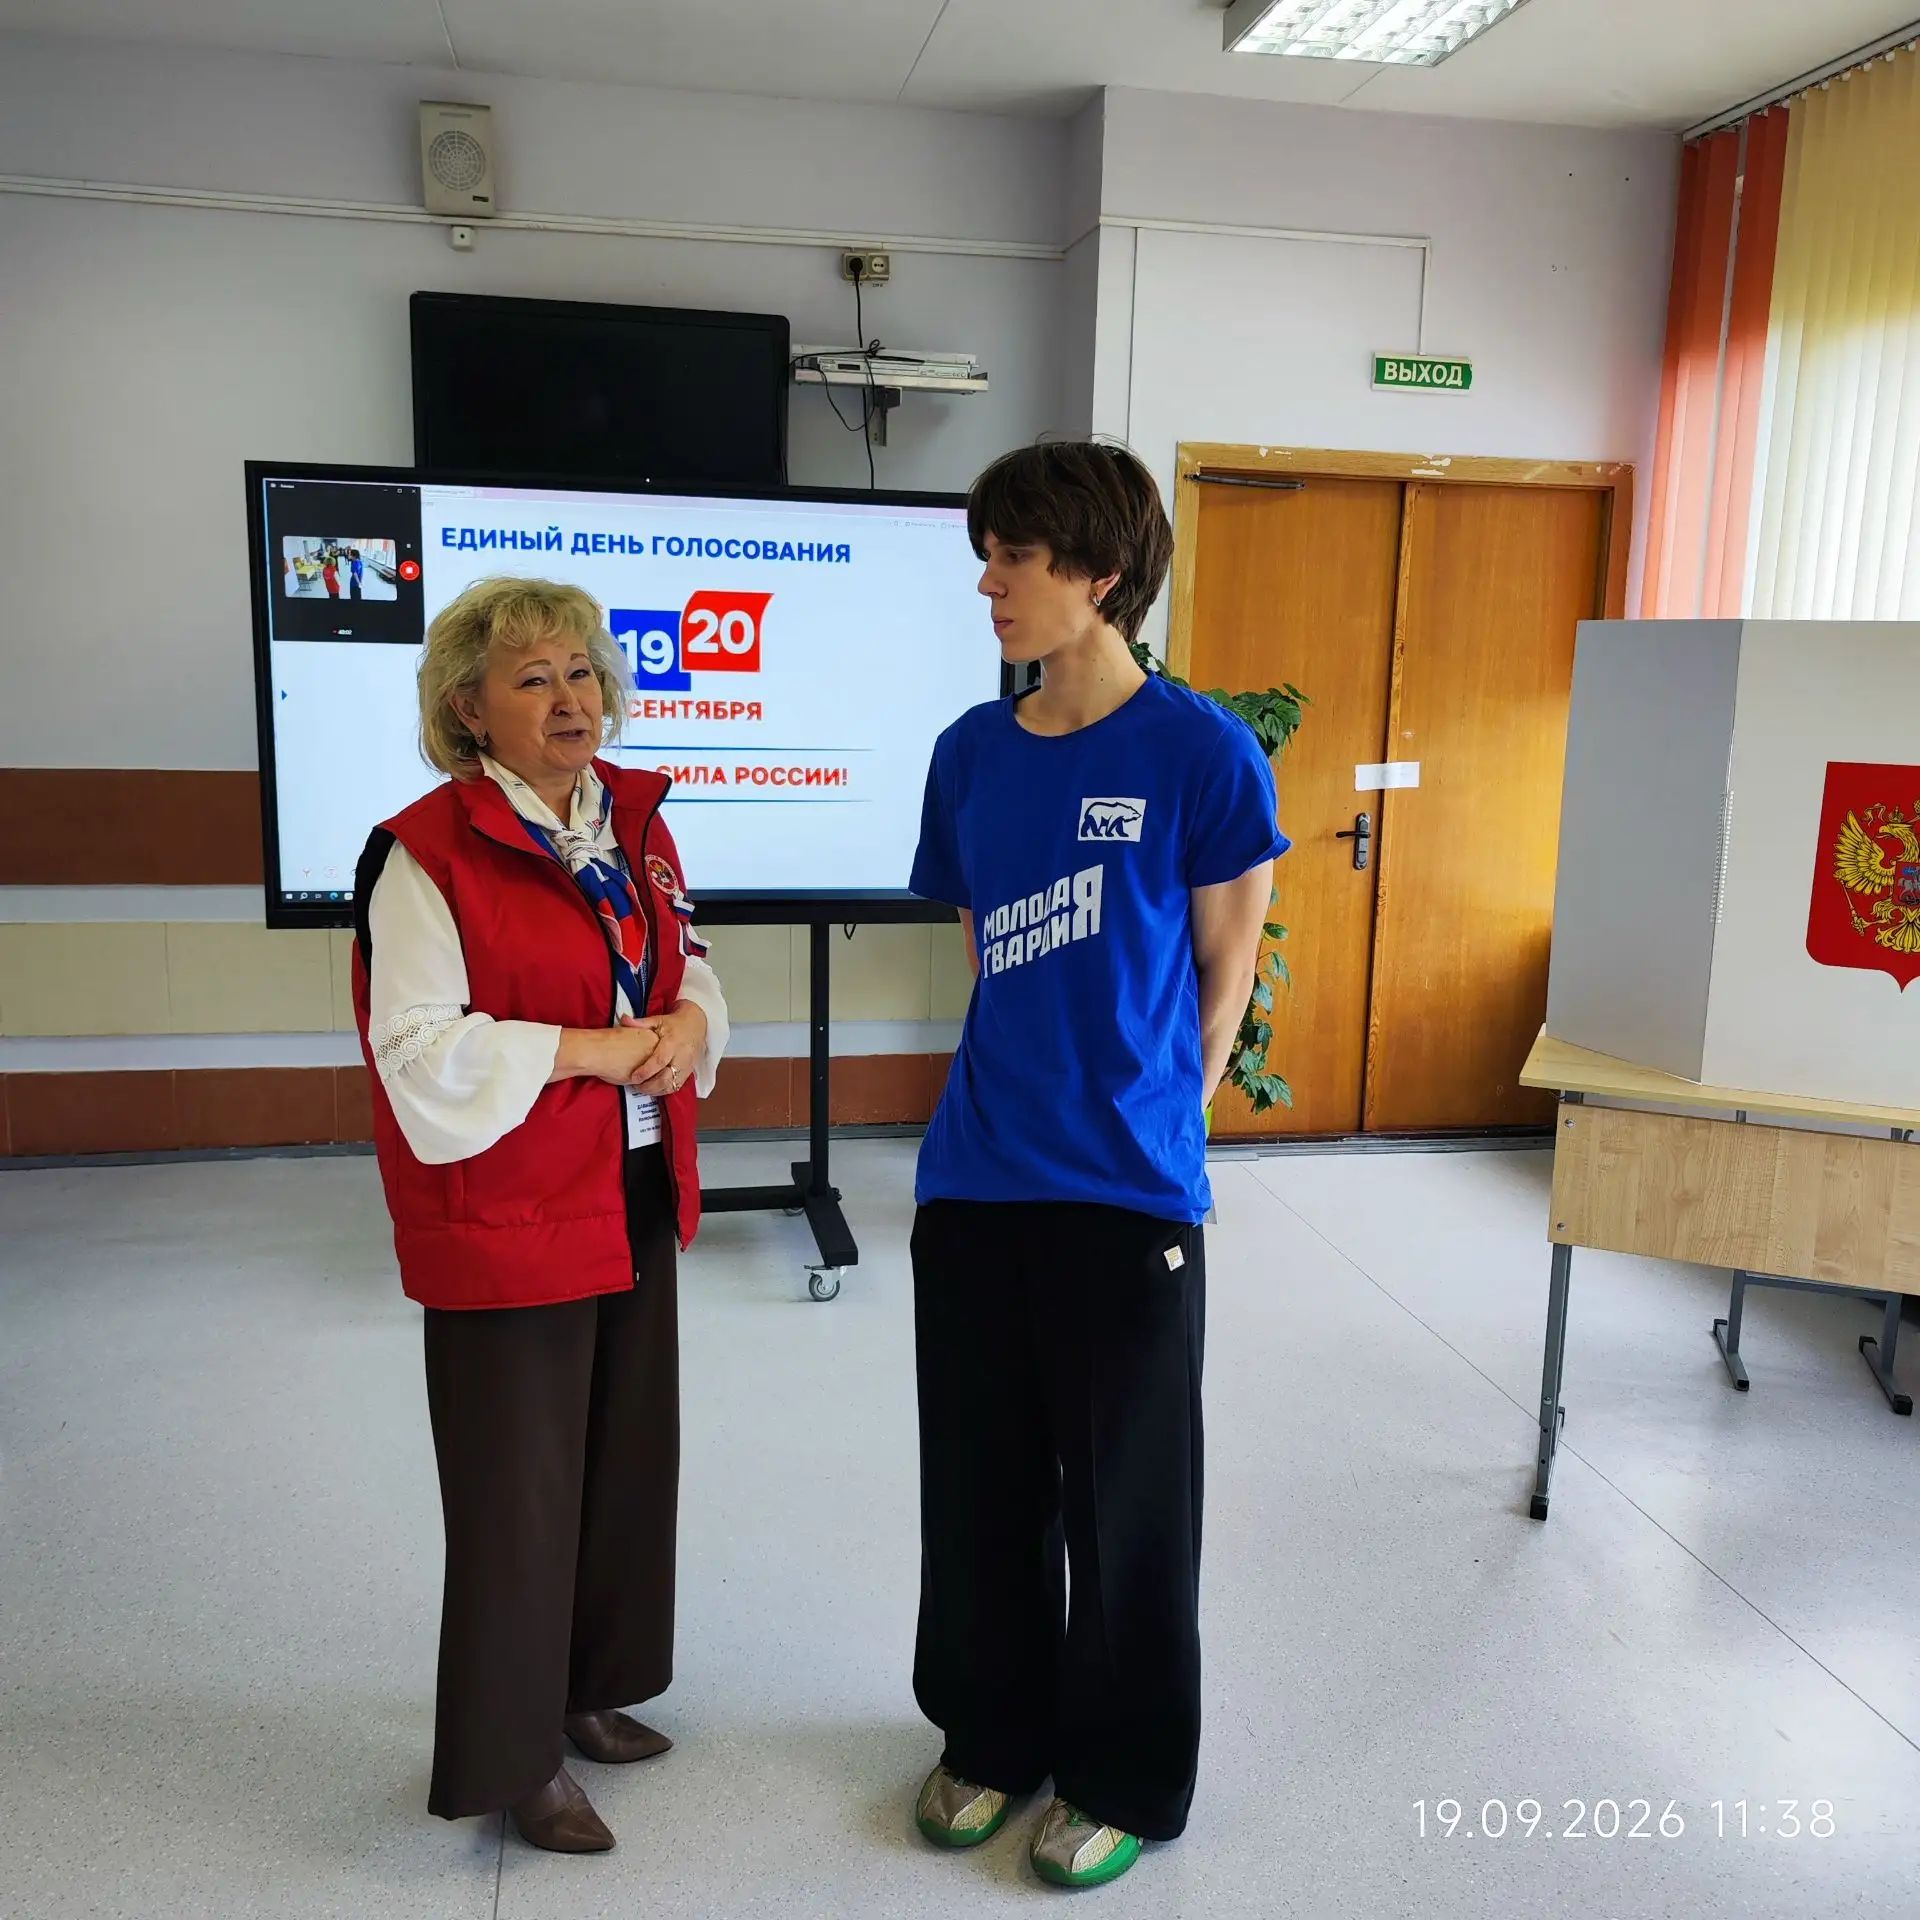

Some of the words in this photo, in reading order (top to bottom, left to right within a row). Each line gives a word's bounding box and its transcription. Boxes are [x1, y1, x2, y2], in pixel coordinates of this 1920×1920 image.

[1384, 361, 1463, 387] ВЫХОД
[441, 526, 563, 551] ЕДИНЫЙ
[570, 532, 644, 555] ДЕНЬ
[652, 536, 851, 563] ГОЛОСОВАНИЯ
[618, 629, 675, 675] 19
[687, 608, 755, 655] 20
[625, 699, 763, 720] СЕНТЯБРЯ
[735, 766, 848, 786] РОССИИ!
